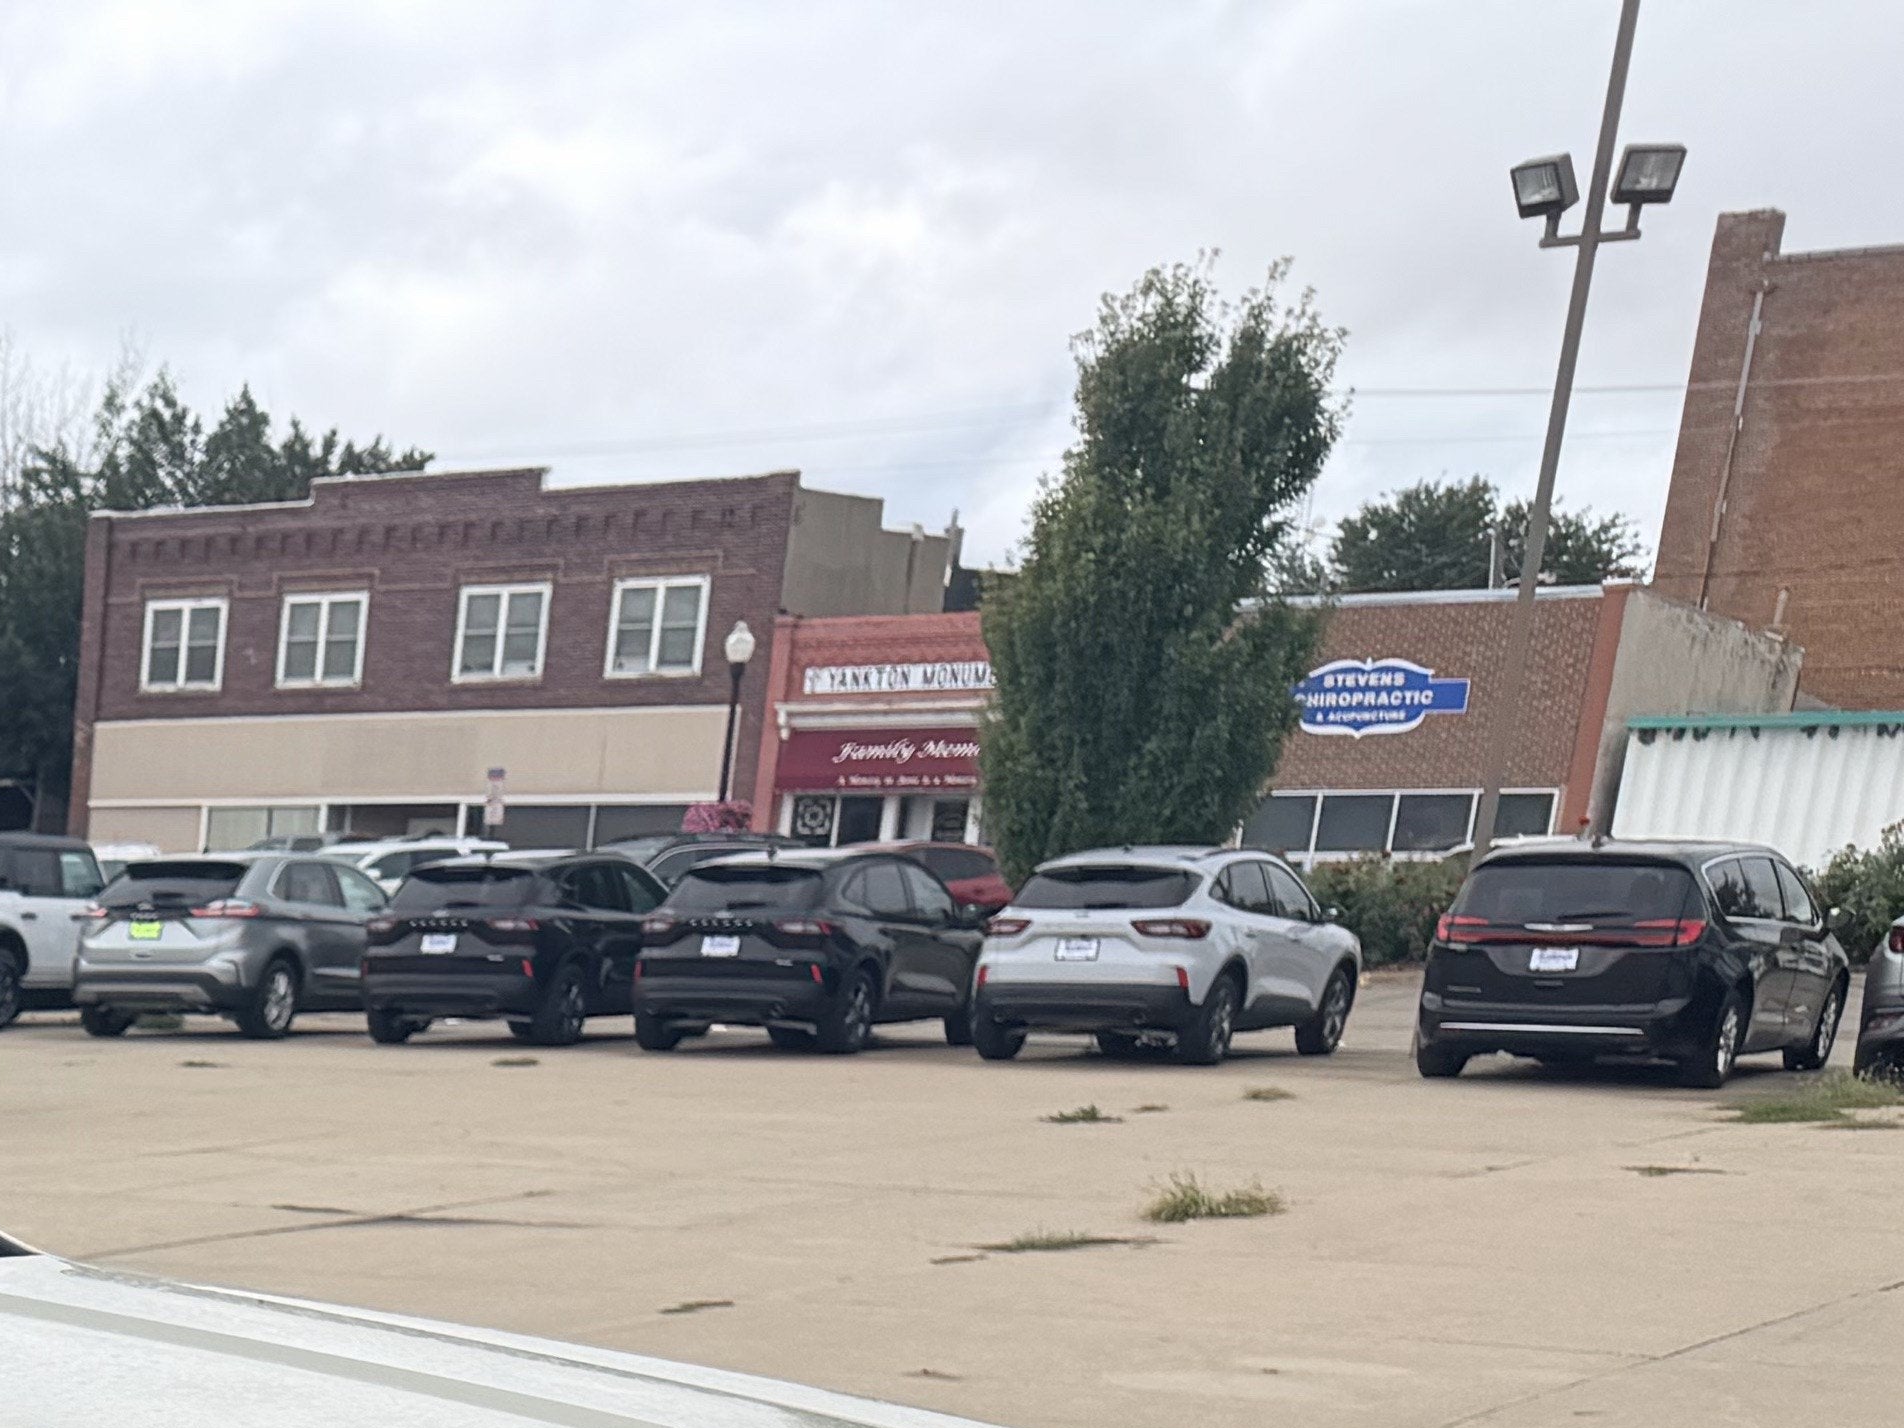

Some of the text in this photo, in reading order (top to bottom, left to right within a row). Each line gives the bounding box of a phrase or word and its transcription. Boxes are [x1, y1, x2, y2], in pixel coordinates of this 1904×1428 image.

[829, 664, 911, 692] YANKTON
[1323, 671, 1405, 689] STEVENS
[832, 738, 917, 765] Family
